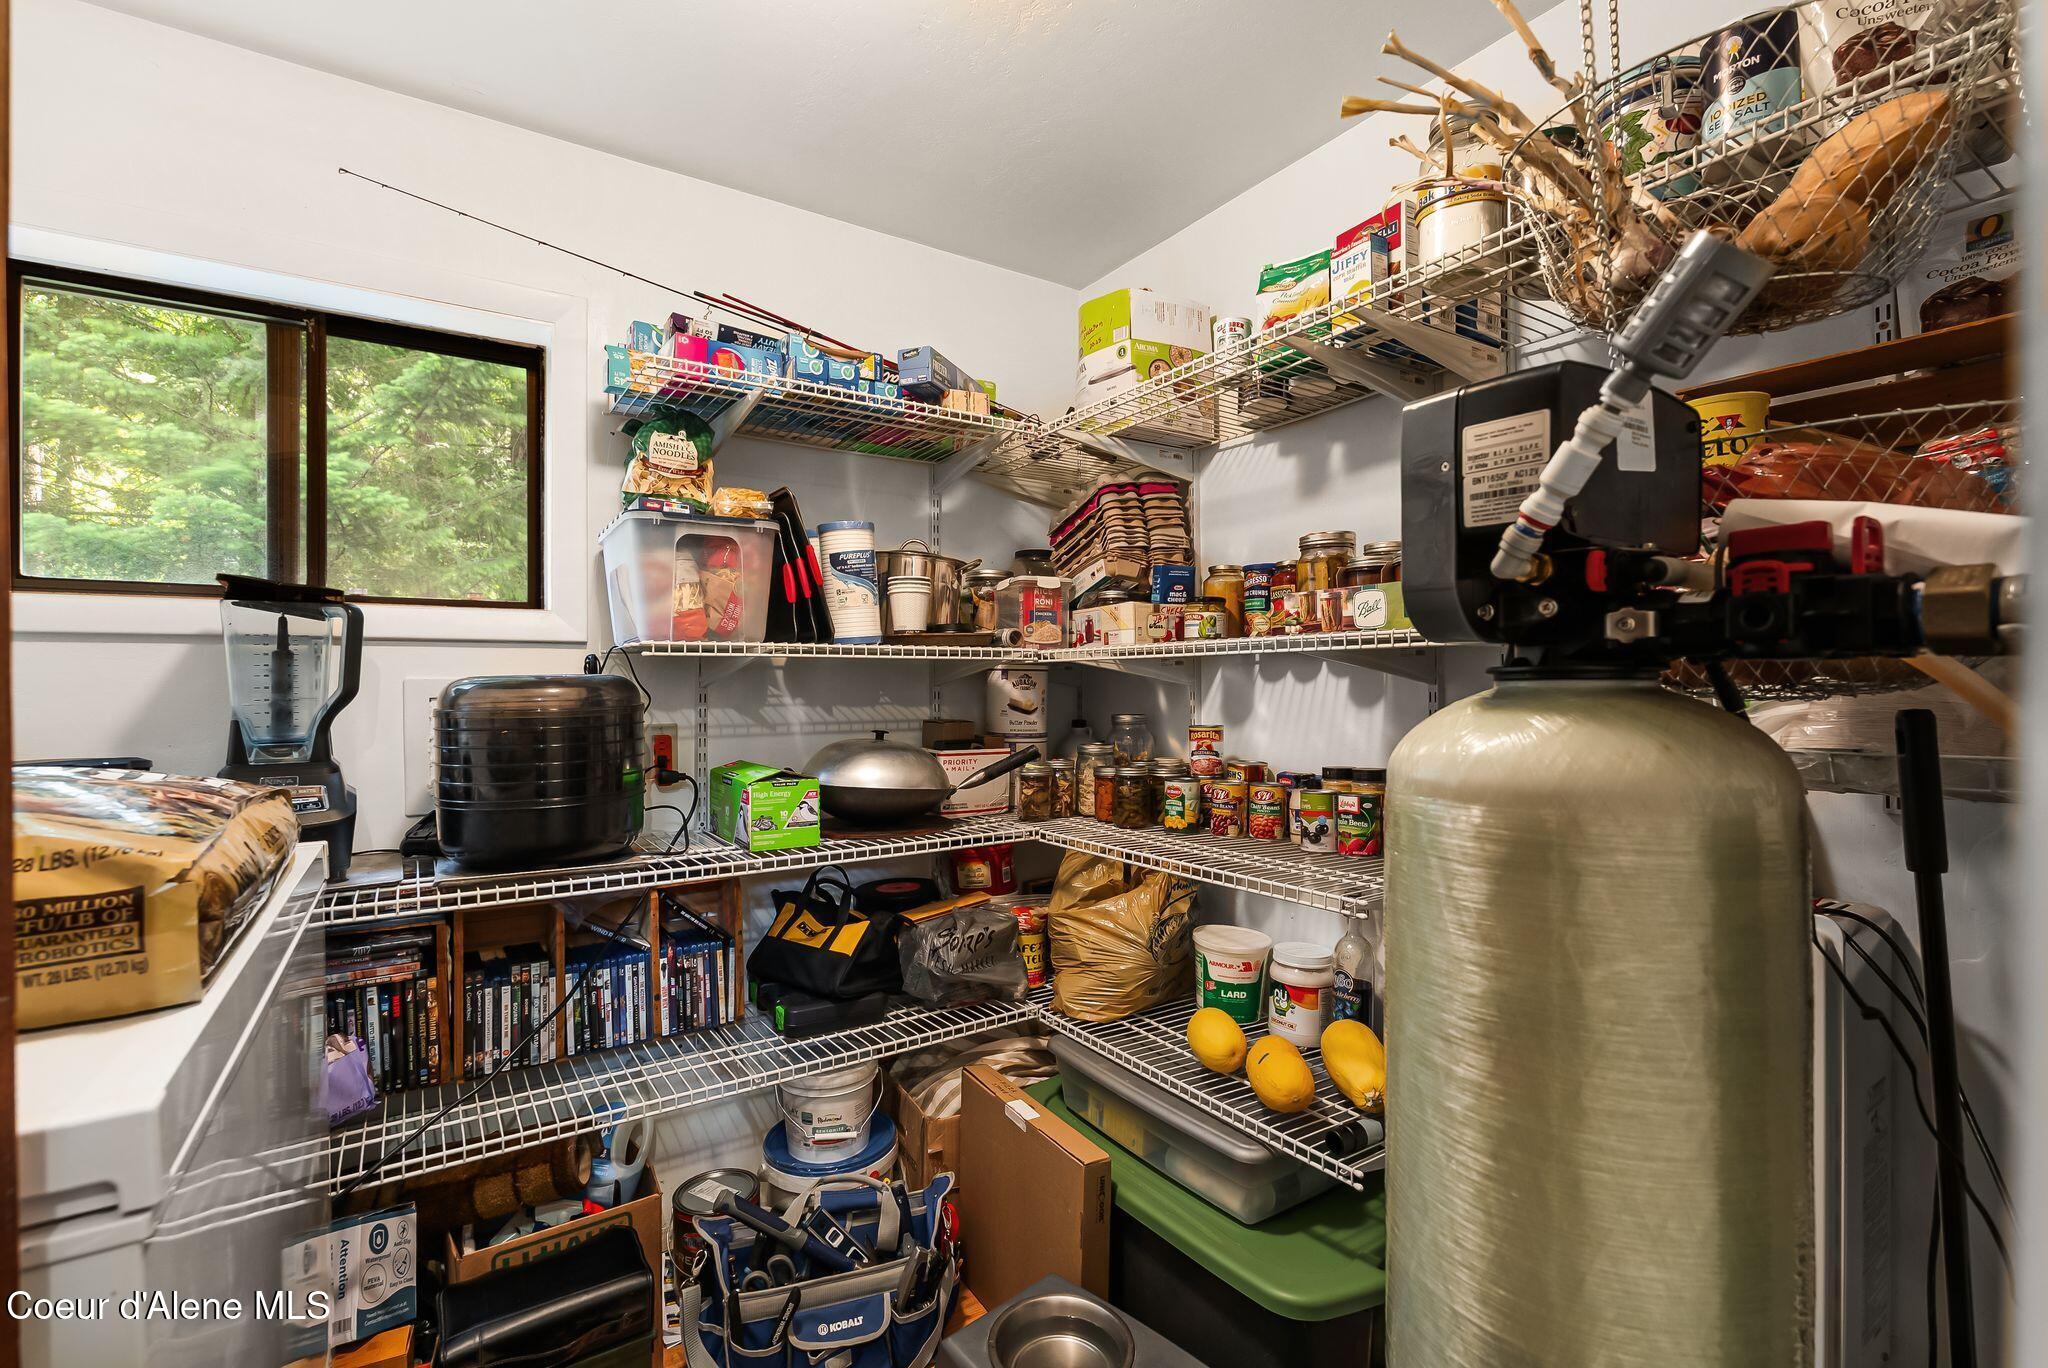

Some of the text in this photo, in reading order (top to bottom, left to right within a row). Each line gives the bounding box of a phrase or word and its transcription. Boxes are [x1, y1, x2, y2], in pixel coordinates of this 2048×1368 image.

[1713, 54, 1761, 83] MORTON
[1710, 91, 1767, 122] IOIZED
[1735, 101, 1770, 119] SALT
[1332, 250, 1368, 275] JIFFY
[1926, 261, 1980, 280] Cocoa
[1134, 342, 1158, 354] AROMA
[653, 441, 679, 450] AMISH
[652, 448, 696, 462] NOODLES
[839, 551, 870, 560] PUREPLUS
[1034, 588, 1052, 596] RICE
[1250, 589, 1268, 597] CRUMBS
[1035, 598, 1053, 606] RONI
[1358, 599, 1382, 618] Ball
[1191, 731, 1220, 741] Rosarita
[943, 758, 978, 766] PRIORITY
[753, 790, 791, 799] High Energy
[1349, 820, 1369, 828] Beets
[39, 849, 80, 873] LBS.
[41, 893, 134, 917] MILLION
[101, 906, 134, 924] OF
[18, 938, 134, 966] ROBIOTICS
[1208, 959, 1237, 970] ARMOUR
[22, 970, 44, 990] WT.
[46, 968, 62, 986] 28
[63, 965, 92, 984] LBS.
[1220, 990, 1248, 998] LARD
[365, 1253, 391, 1264] Waterproof
[338, 1239, 350, 1300] Attention
[364, 1282, 384, 1291] material
[829, 1316, 864, 1332] KOBALT
